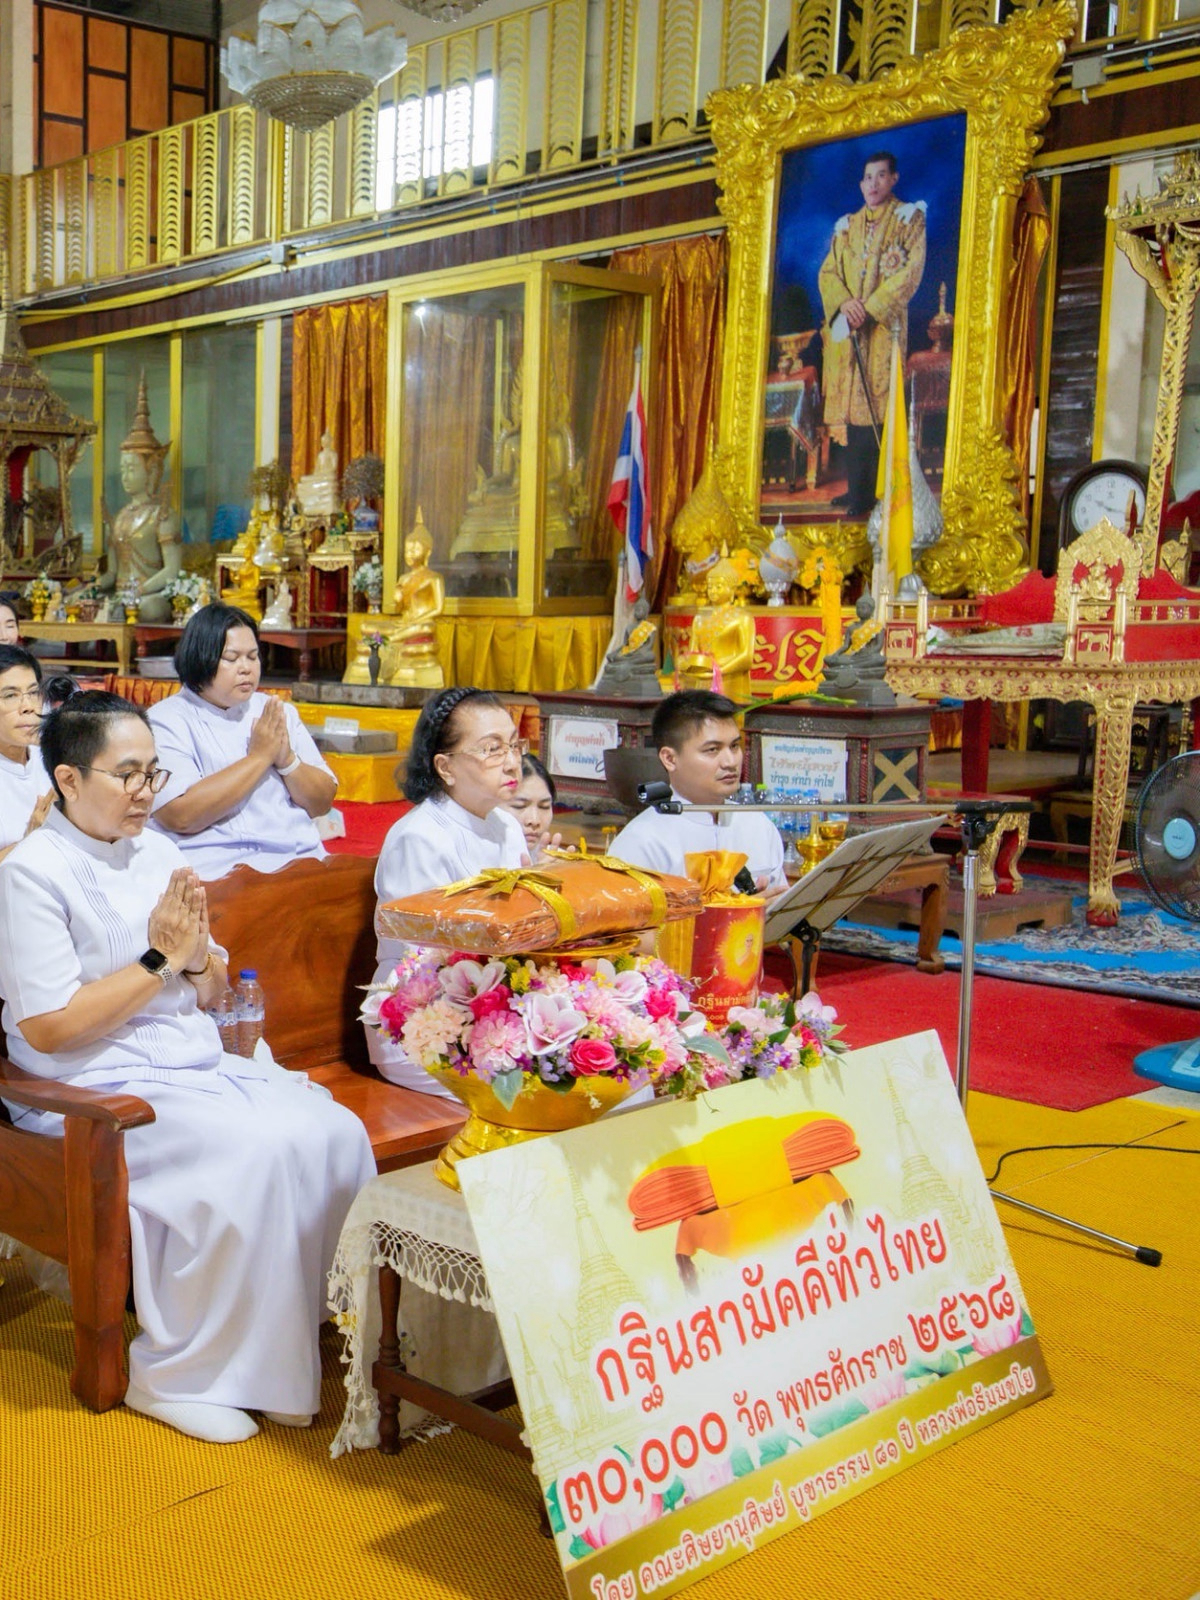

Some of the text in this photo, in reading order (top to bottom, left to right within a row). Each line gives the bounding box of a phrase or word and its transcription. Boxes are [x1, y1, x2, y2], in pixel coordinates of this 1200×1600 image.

[563, 1273, 1016, 1524] ๓๐,๐๐๐ วัด พุทธศักราช ๒๕๖๘
[595, 1212, 948, 1413] กฐินสามัคคีทั่วไทย
[640, 1484, 787, 1588] คณะศิษยานุศิษย์
[789, 1453, 871, 1518] บูชาธรรม
[874, 1441, 899, 1466] ๘๑
[898, 1420, 915, 1450] ปี
[917, 1365, 1034, 1442] หลวงพ่อธัมมชโย
